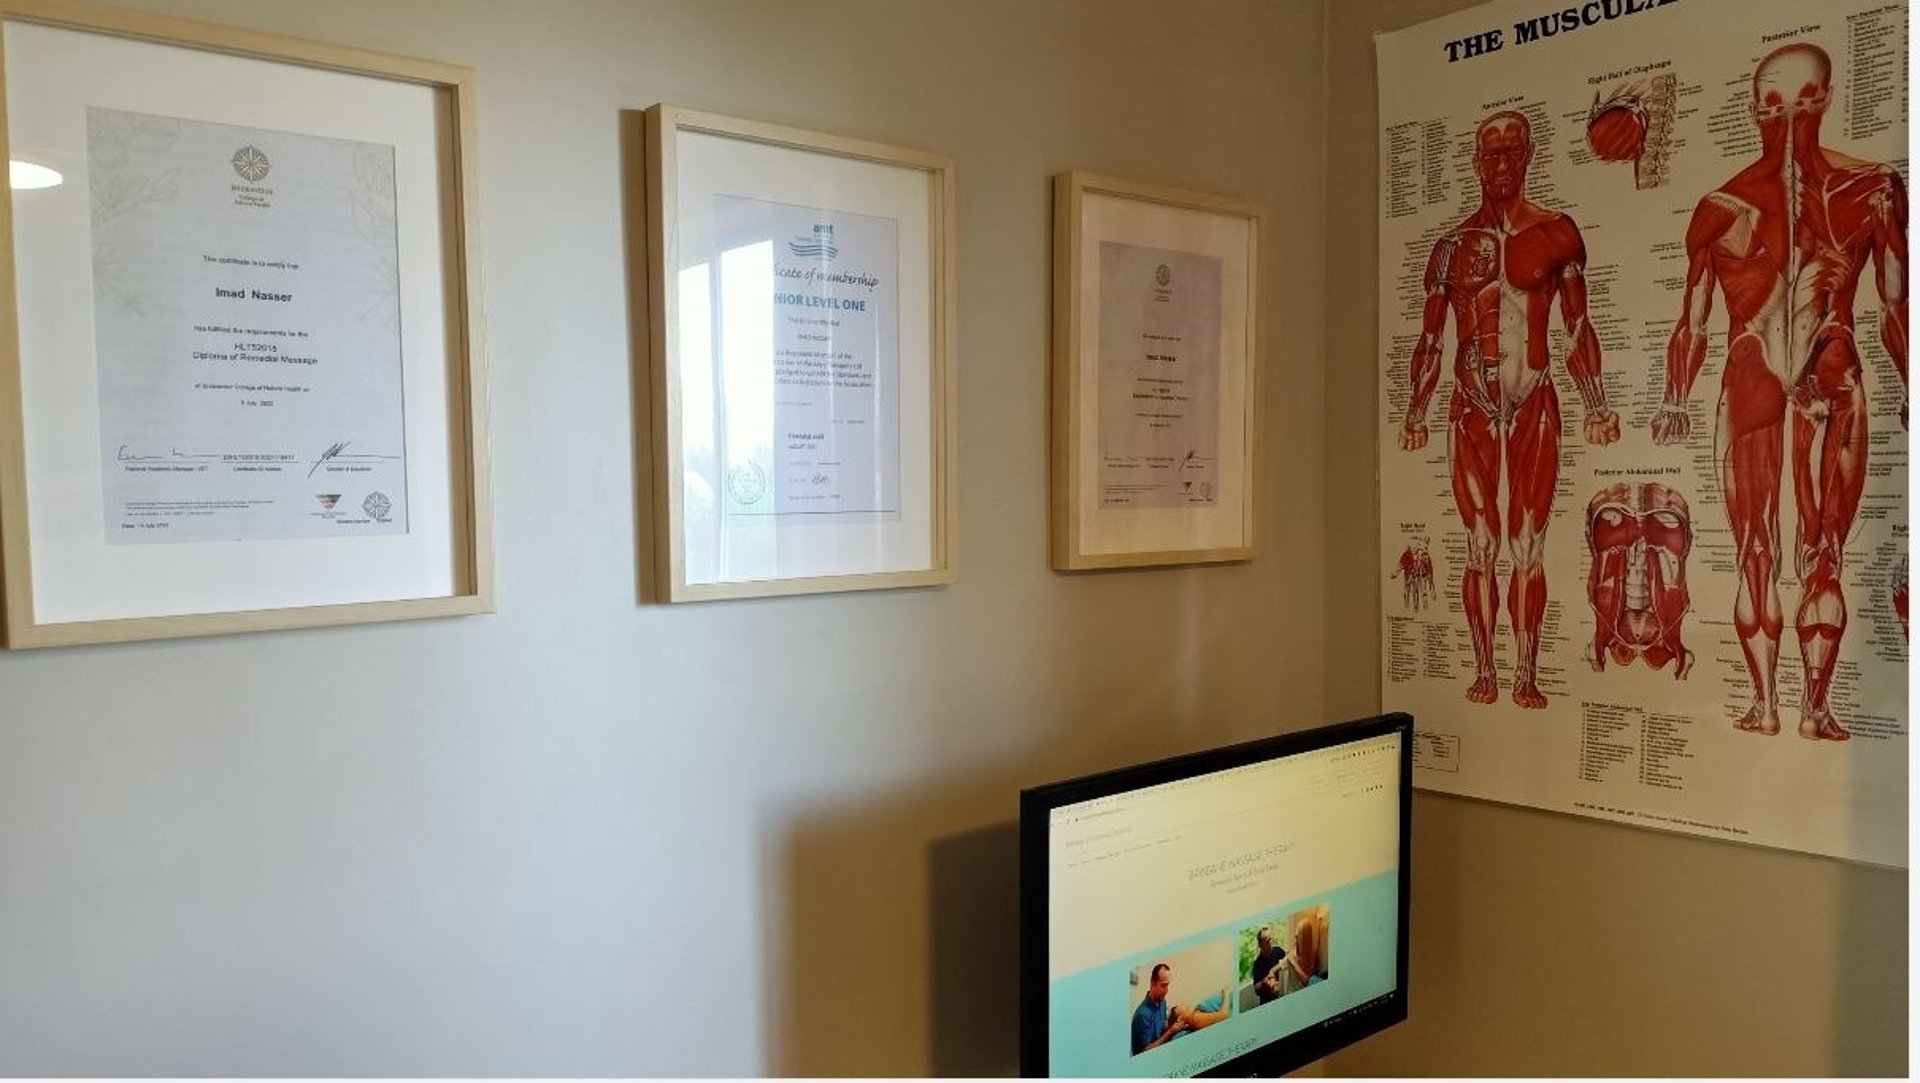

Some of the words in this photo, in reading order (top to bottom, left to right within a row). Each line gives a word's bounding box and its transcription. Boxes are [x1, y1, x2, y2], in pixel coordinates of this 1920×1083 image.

[1443, 29, 1504, 63] THE
[215, 286, 246, 300] Imad
[251, 289, 293, 303] Nasser
[805, 295, 841, 310] LEVEL
[842, 298, 866, 312] ONE
[193, 350, 229, 363] Diploma
